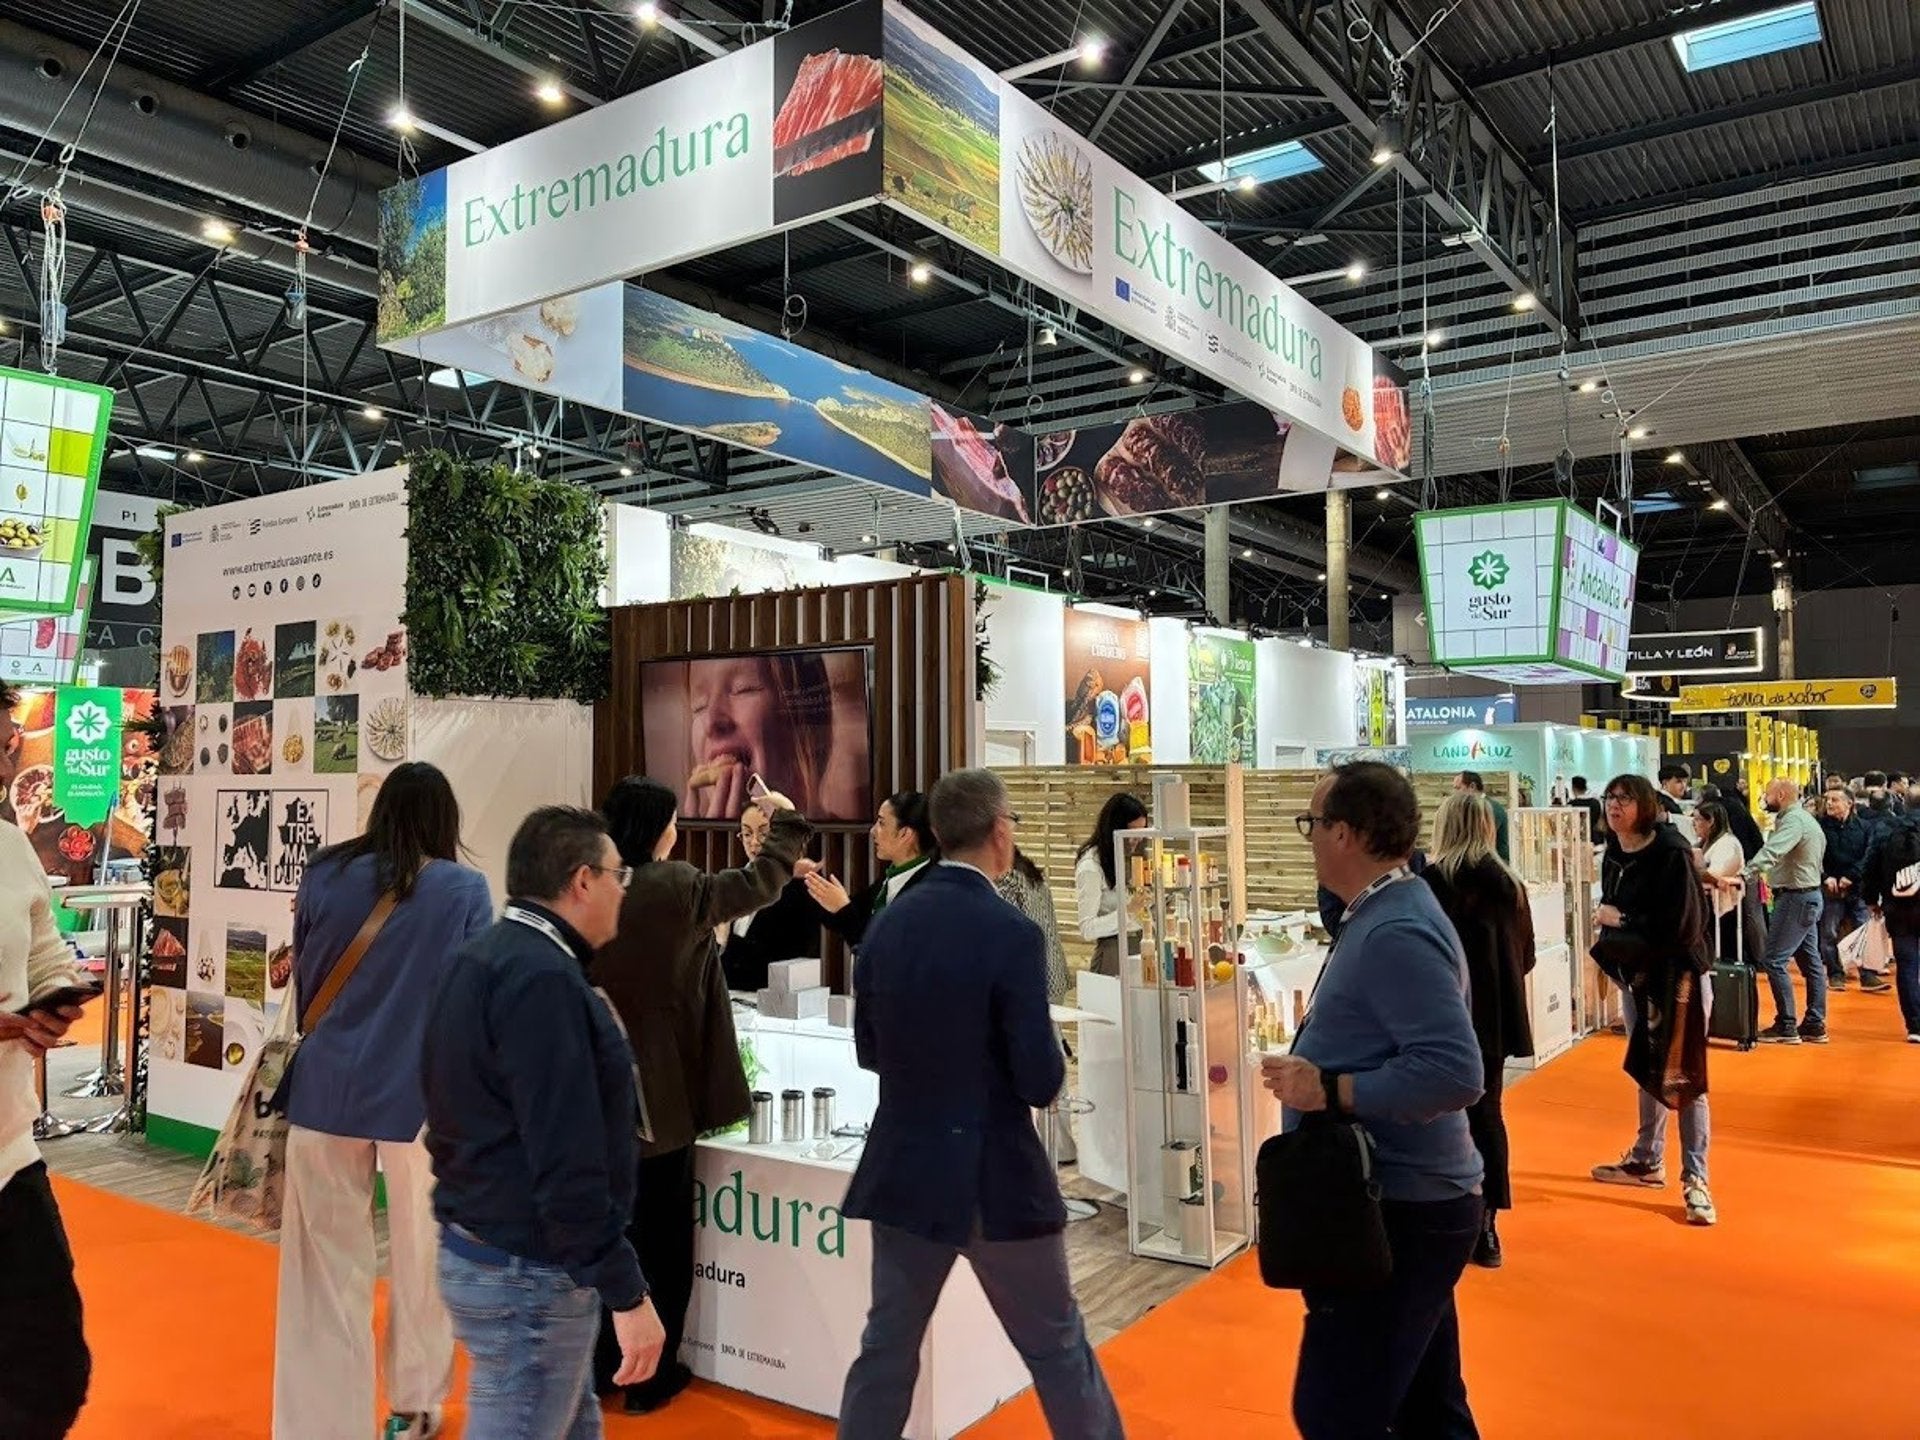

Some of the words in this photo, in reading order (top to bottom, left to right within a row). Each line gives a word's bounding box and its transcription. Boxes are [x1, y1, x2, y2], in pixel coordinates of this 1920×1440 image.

[465, 112, 749, 248] Extremadura
[1113, 186, 1323, 381] Extremadura
[122, 510, 137, 522] P1
[102, 537, 157, 606] B
[222, 549, 334, 577] www.extremaduraavante.es
[1468, 592, 1512, 613] gusto
[1482, 606, 1512, 620] Sur
[97, 624, 116, 646] A
[1665, 649, 1674, 659] Y
[1677, 645, 1713, 659] LEÓN
[64, 747, 111, 766] gusto
[79, 760, 111, 777] Sur
[287, 822, 314, 844] TRE
[285, 844, 308, 865] MA
